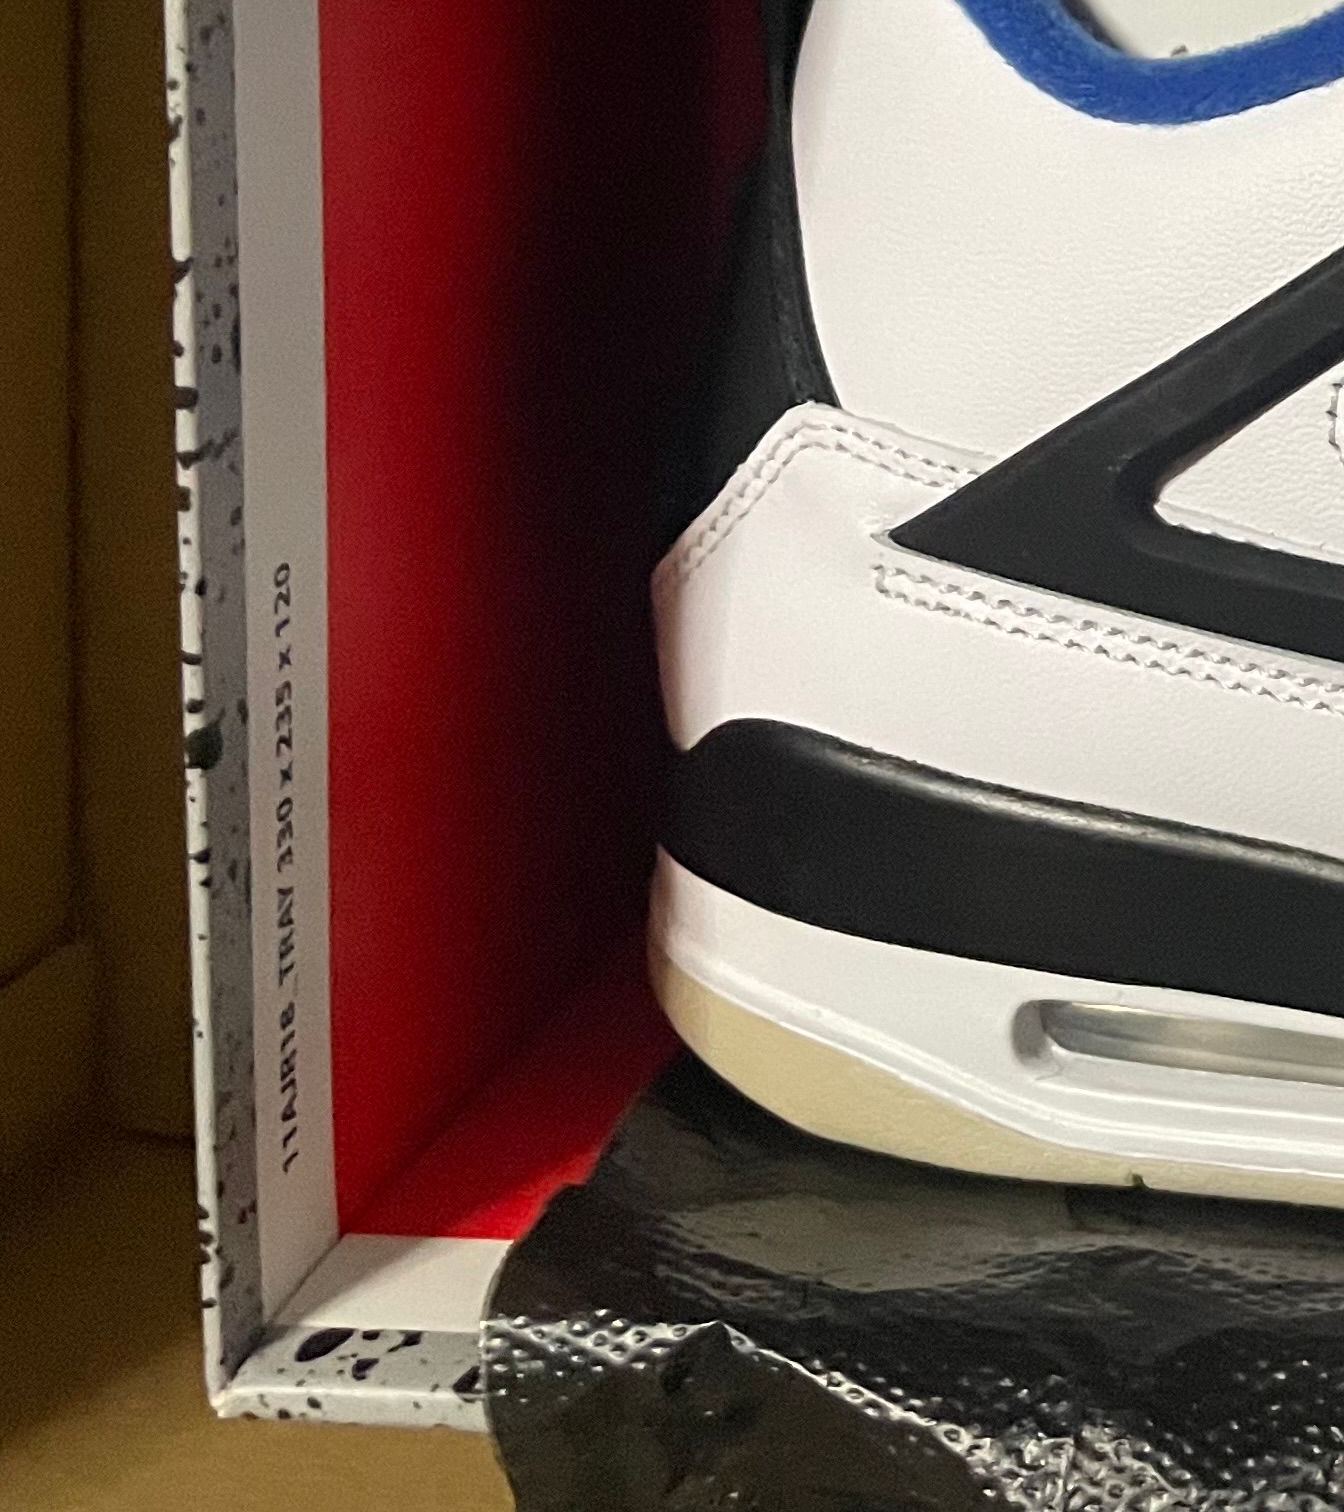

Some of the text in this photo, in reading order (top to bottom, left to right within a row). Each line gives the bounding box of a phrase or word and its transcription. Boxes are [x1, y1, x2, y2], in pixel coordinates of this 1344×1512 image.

[274, 562, 290, 638] 120
[275, 680, 292, 758] 235
[276, 797, 294, 874] 330
